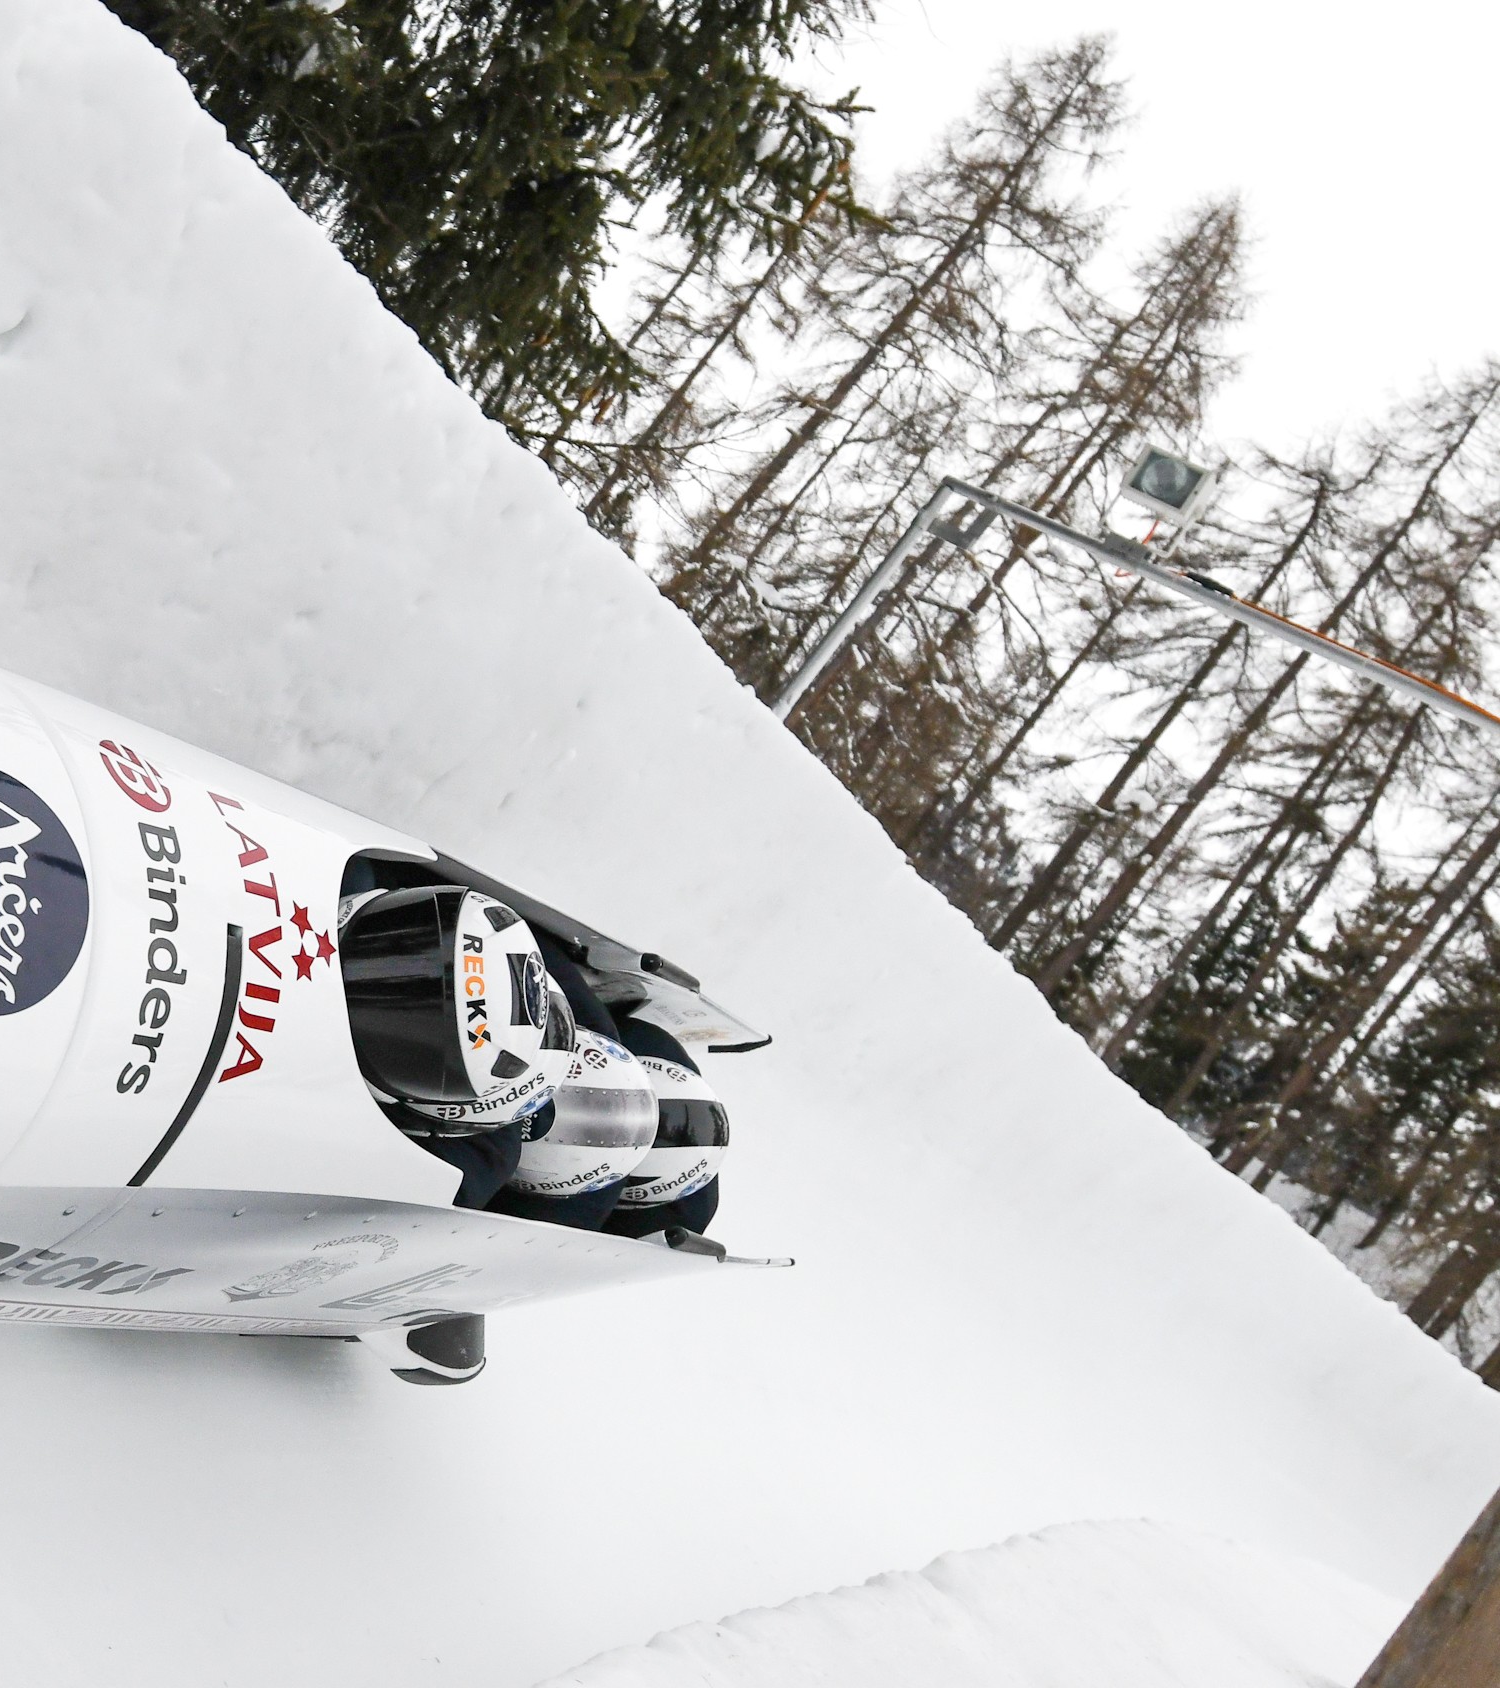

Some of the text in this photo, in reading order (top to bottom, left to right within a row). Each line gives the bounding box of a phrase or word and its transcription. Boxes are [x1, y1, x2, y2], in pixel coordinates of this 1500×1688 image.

[116, 821, 187, 1094] Binders
[207, 791, 283, 1083] LATVIJA
[471, 1072, 545, 1114] Binders
[538, 1162, 610, 1192] Binders
[650, 1158, 708, 1195] Binders
